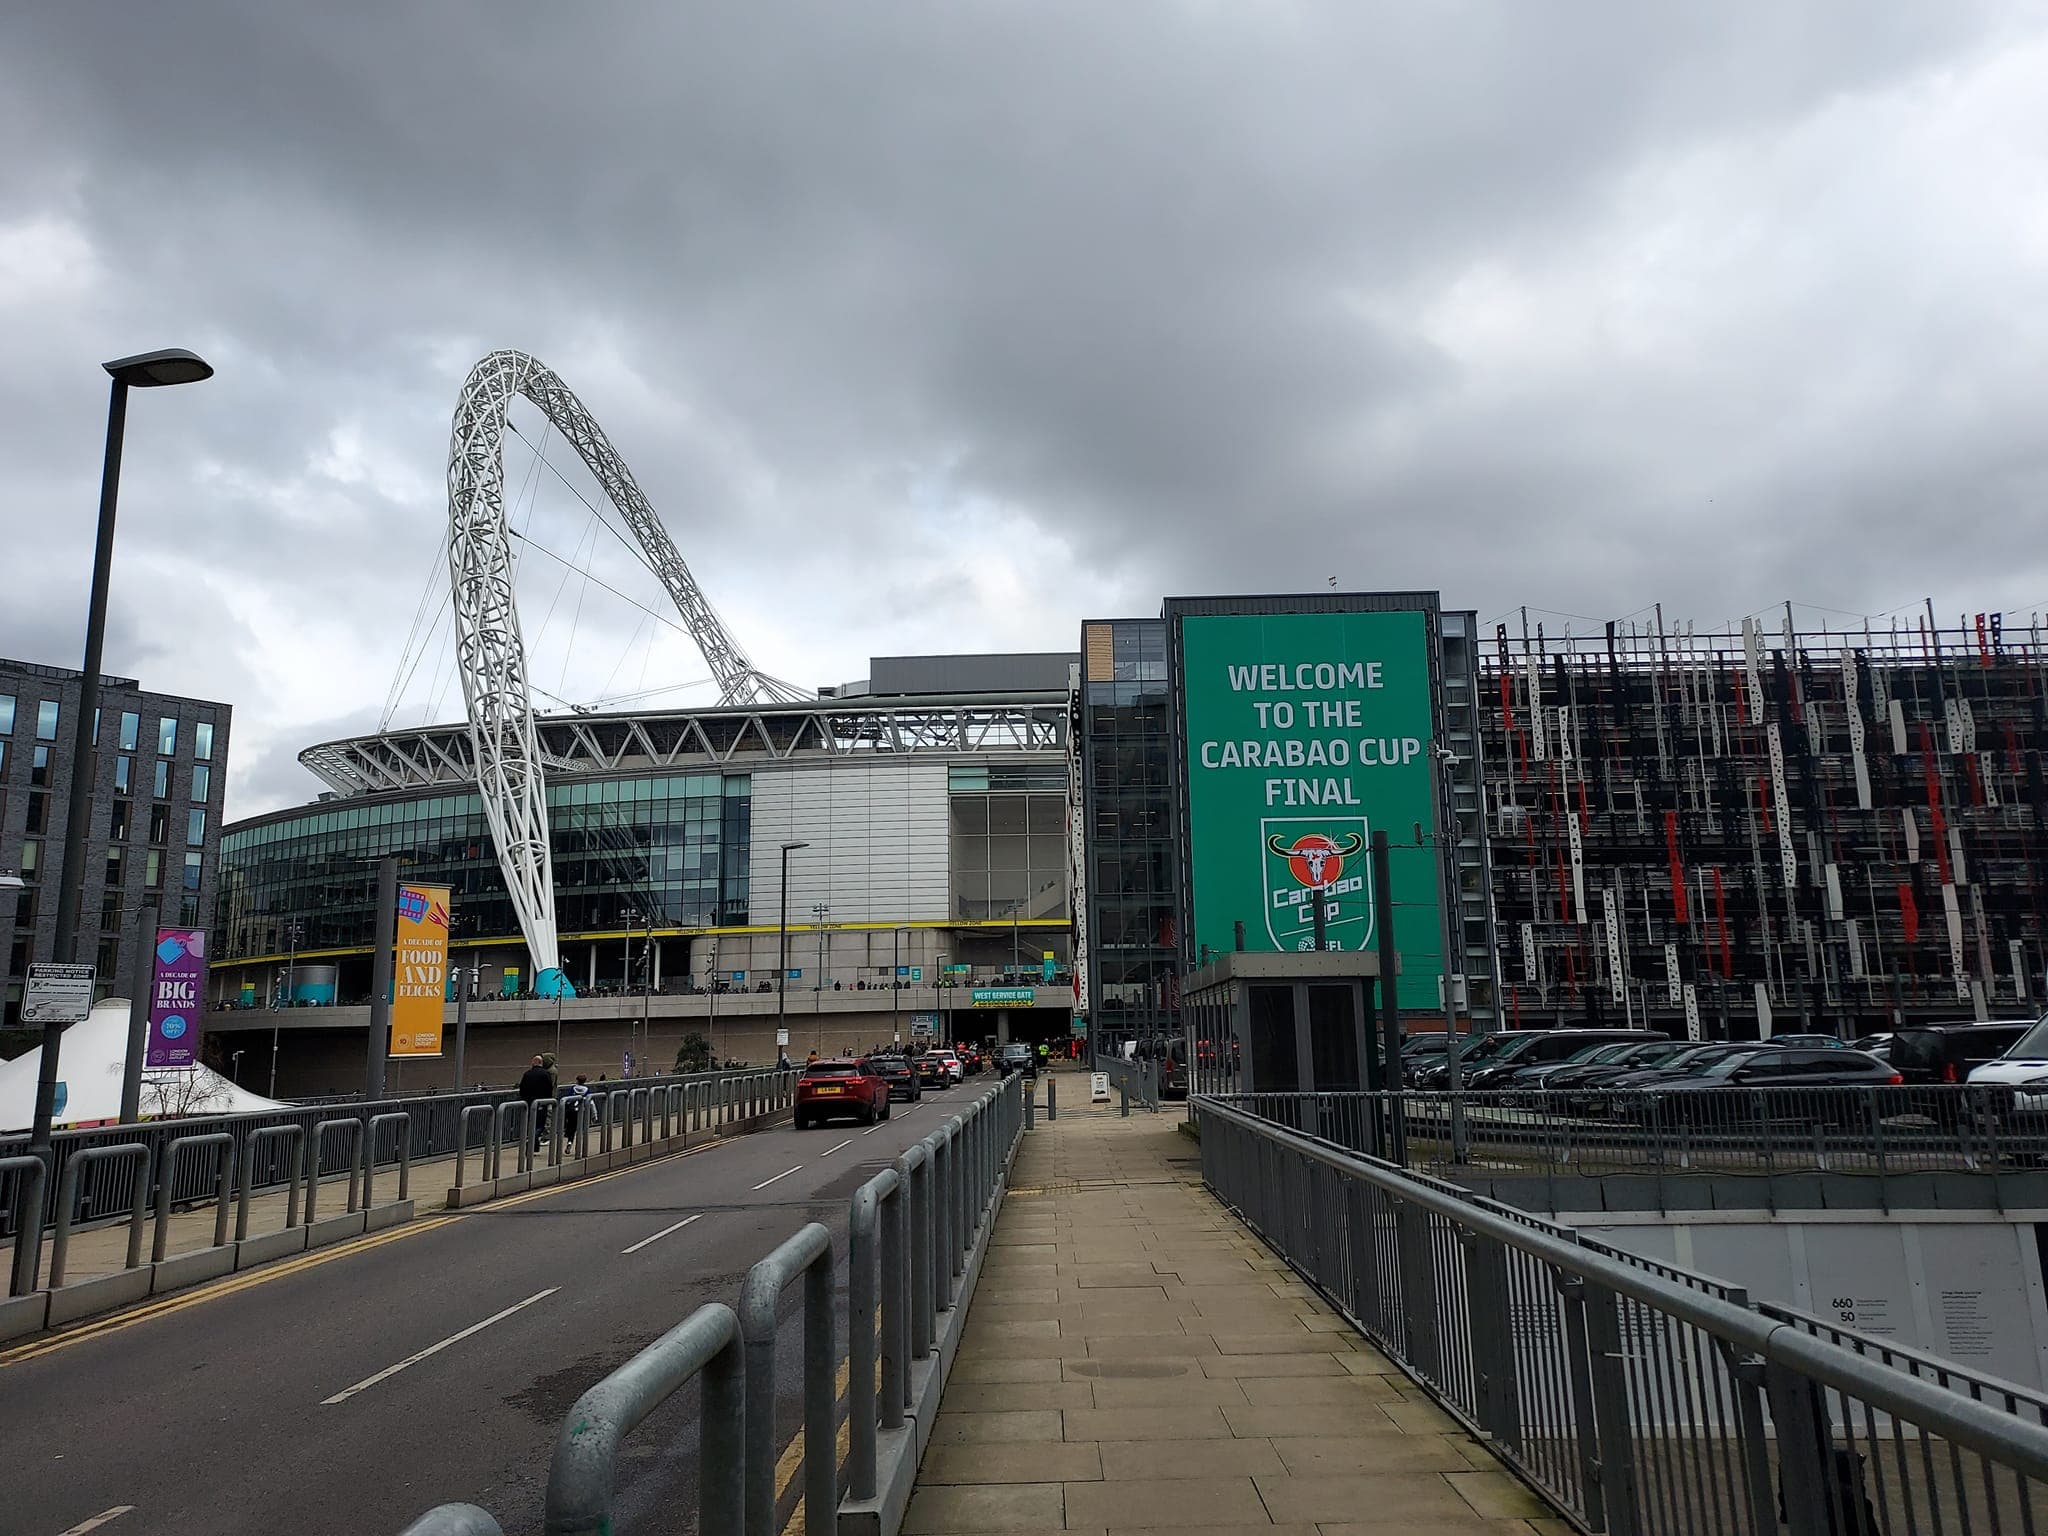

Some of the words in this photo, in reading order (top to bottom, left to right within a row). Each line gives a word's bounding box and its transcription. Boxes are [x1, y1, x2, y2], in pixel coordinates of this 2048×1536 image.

[1228, 662, 1384, 691] WELCOME
[1253, 701, 1294, 729] TO
[1302, 700, 1362, 728] THE
[1201, 739, 1350, 768] CARABAO
[1359, 738, 1420, 765] CUP
[1265, 778, 1361, 806] FINAL
[408, 938, 433, 946] DECADE
[401, 949, 442, 965] FOOD
[400, 966, 442, 984] AND
[158, 981, 196, 1000] BIG
[399, 984, 441, 997] FLICKS
[974, 991, 991, 1000] WEST
[991, 991, 1017, 1000] SERVICE
[1017, 991, 1032, 1000] GATE
[156, 1000, 196, 1009] BRANDS
[1832, 1297, 1853, 1309] 660
[1841, 1311, 1855, 1322] 50
